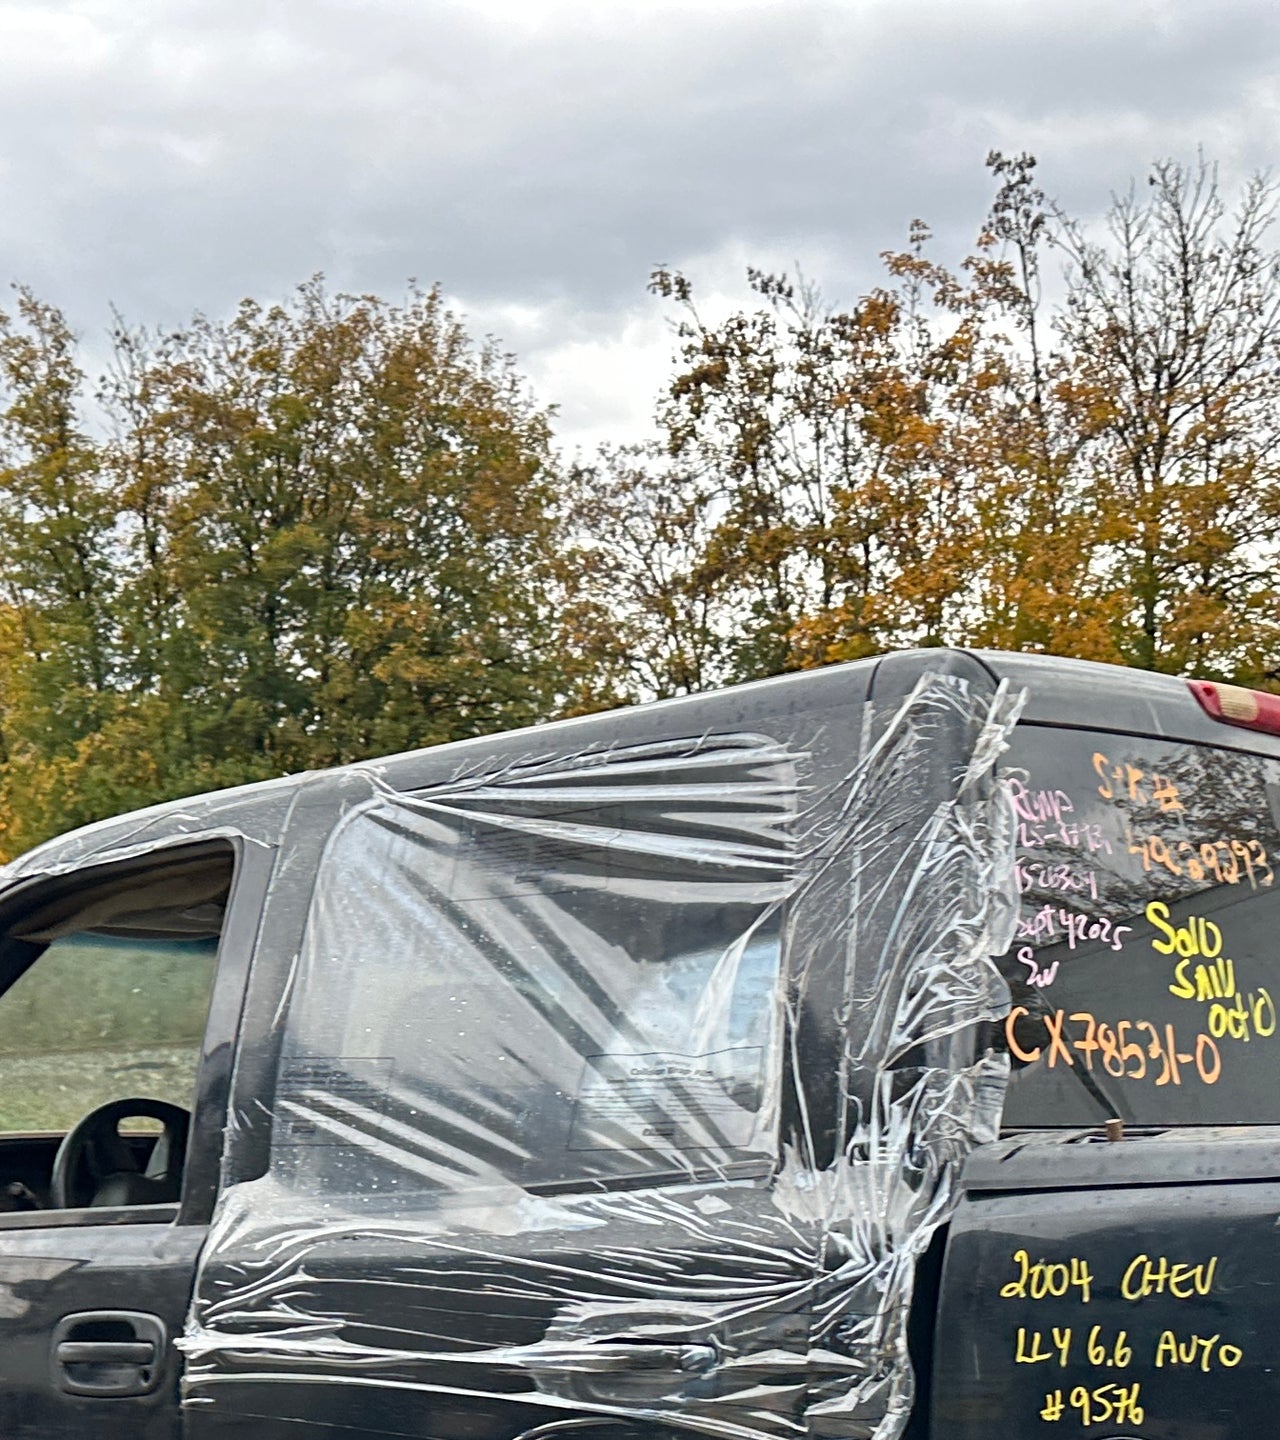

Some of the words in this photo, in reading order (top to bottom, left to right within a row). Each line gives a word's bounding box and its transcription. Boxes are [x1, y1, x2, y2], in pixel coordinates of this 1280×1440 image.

[1000, 1249, 1094, 1303] 2004
[1121, 1254, 1218, 1301] CHEV
[1087, 1325, 1132, 1368] 6.6
